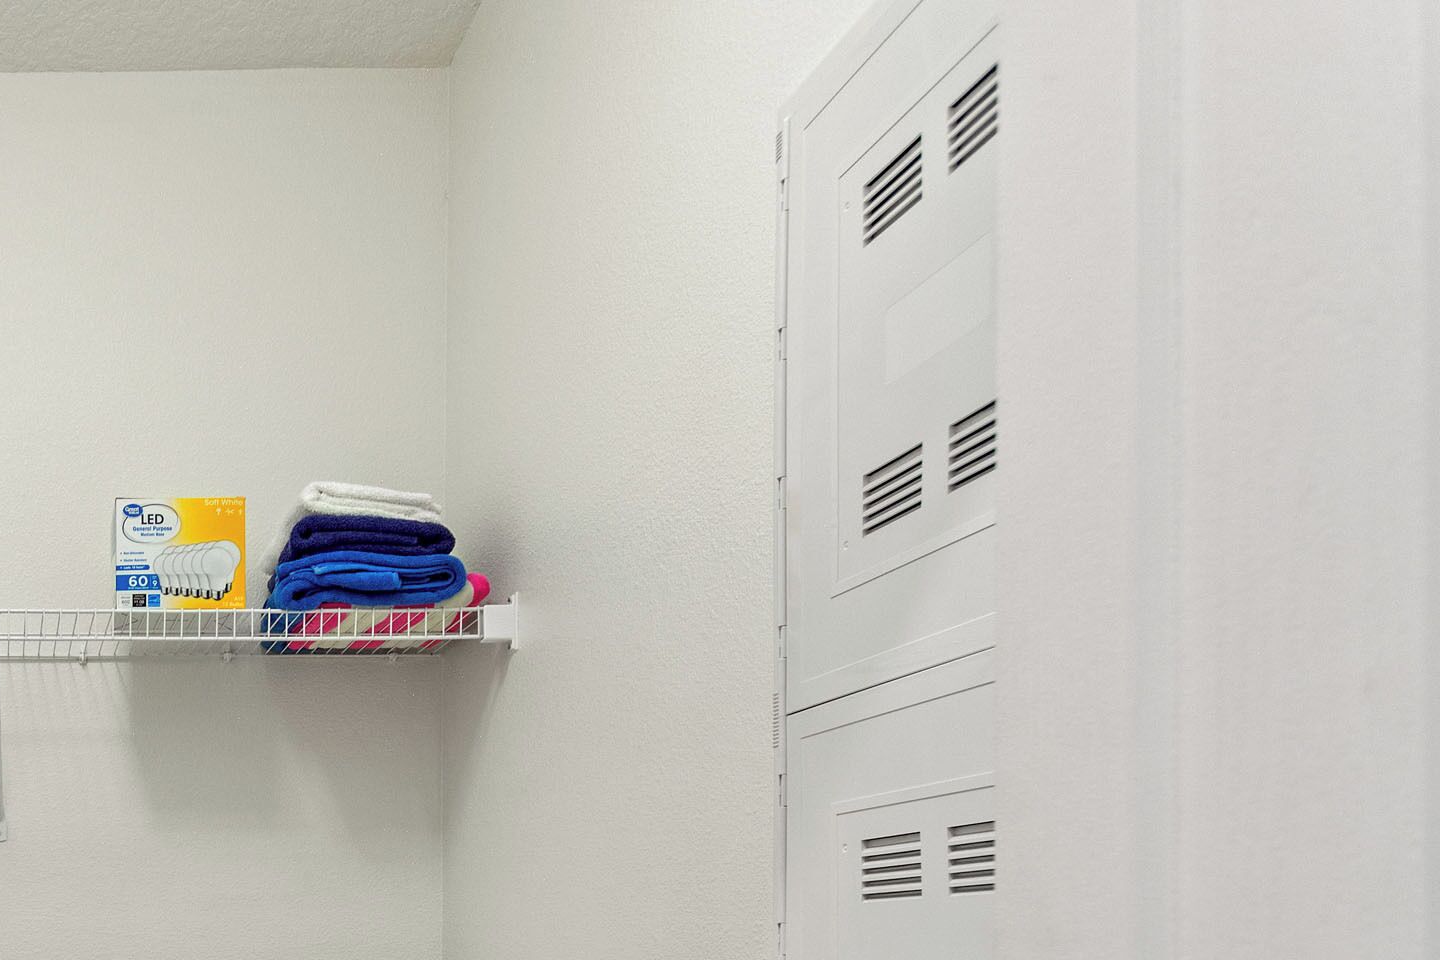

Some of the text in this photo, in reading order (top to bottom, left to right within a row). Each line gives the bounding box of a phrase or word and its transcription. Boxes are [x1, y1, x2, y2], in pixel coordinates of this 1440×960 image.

[141, 513, 164, 525] LED
[128, 575, 149, 587] 60
[152, 579, 158, 587] 9
